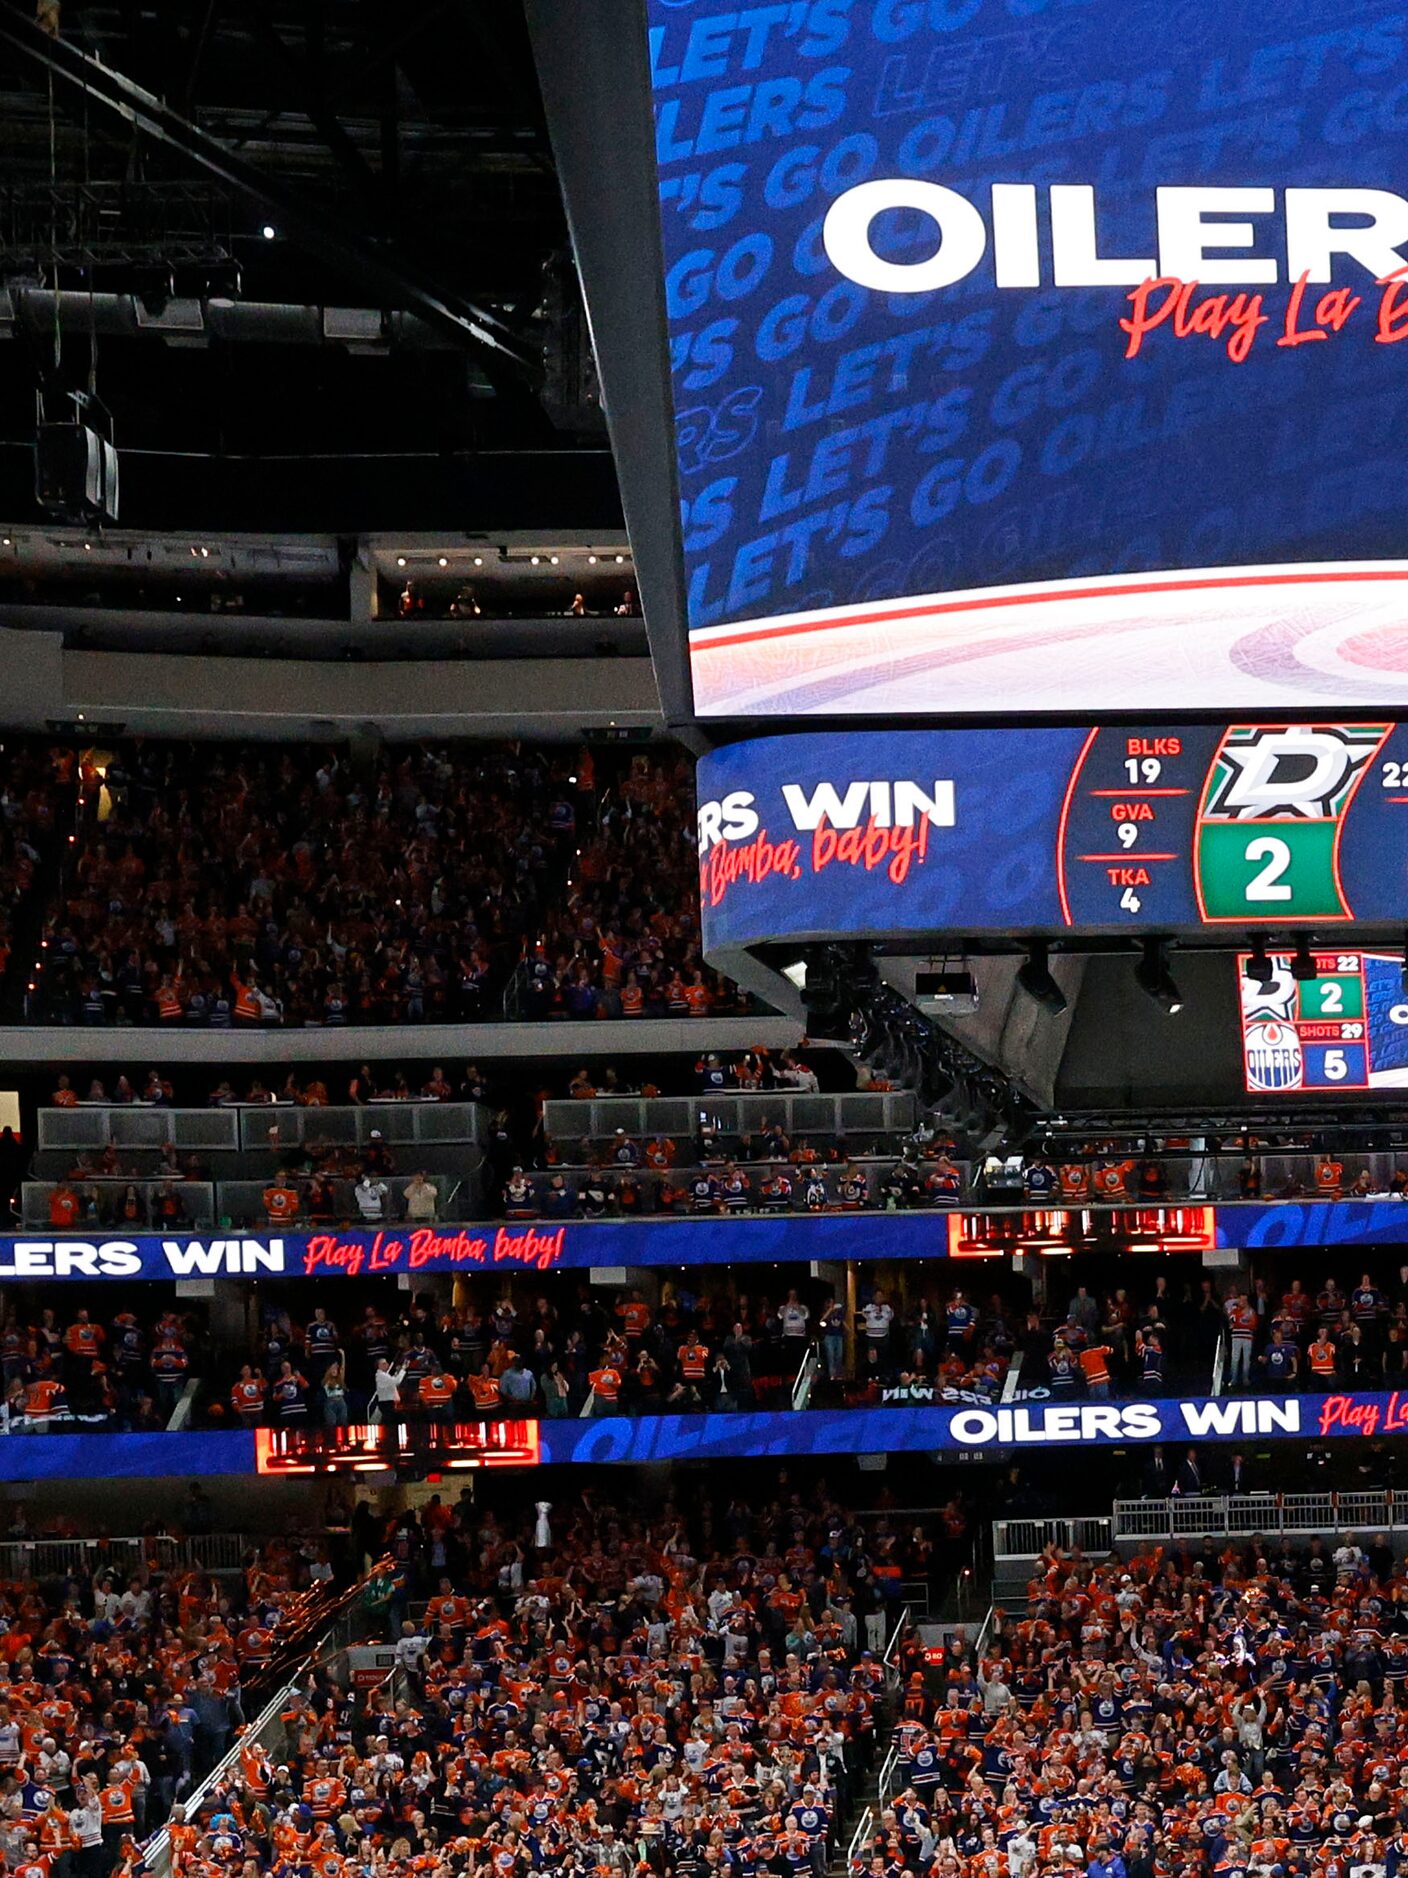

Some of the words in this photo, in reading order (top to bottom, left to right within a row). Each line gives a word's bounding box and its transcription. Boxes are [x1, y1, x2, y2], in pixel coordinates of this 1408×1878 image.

[648, 0, 852, 90] LET'S
[1119, 274, 1270, 364] Play
[1276, 269, 1362, 347] La
[784, 309, 998, 431] LET'S
[759, 386, 975, 522] LET'S
[687, 486, 895, 629] LET'S
[1127, 737, 1183, 756] BLKS
[1124, 758, 1162, 784] 19
[781, 780, 955, 831] WIN
[1111, 803, 1155, 822] GVA
[1117, 823, 1138, 849] 9
[708, 829, 802, 907] Bamba,
[812, 811, 930, 885] baby!
[1106, 868, 1151, 887] TKA
[1245, 836, 1292, 902] 2
[1120, 888, 1141, 914] 4
[1336, 955, 1360, 972] 22
[1319, 981, 1344, 1013] 2
[1301, 1025, 1340, 1037] SHOTS
[1341, 1022, 1364, 1039] 29
[1324, 1049, 1348, 1081] 5
[162, 1239, 286, 1275] WIN
[303, 1235, 366, 1276] Play
[369, 1231, 404, 1270] La
[408, 1228, 488, 1269] Bamba,
[493, 1227, 565, 1269] baby!
[950, 1403, 1162, 1444] OILERS
[1186, 1399, 1300, 1436] WIN
[1318, 1395, 1381, 1436] Play
